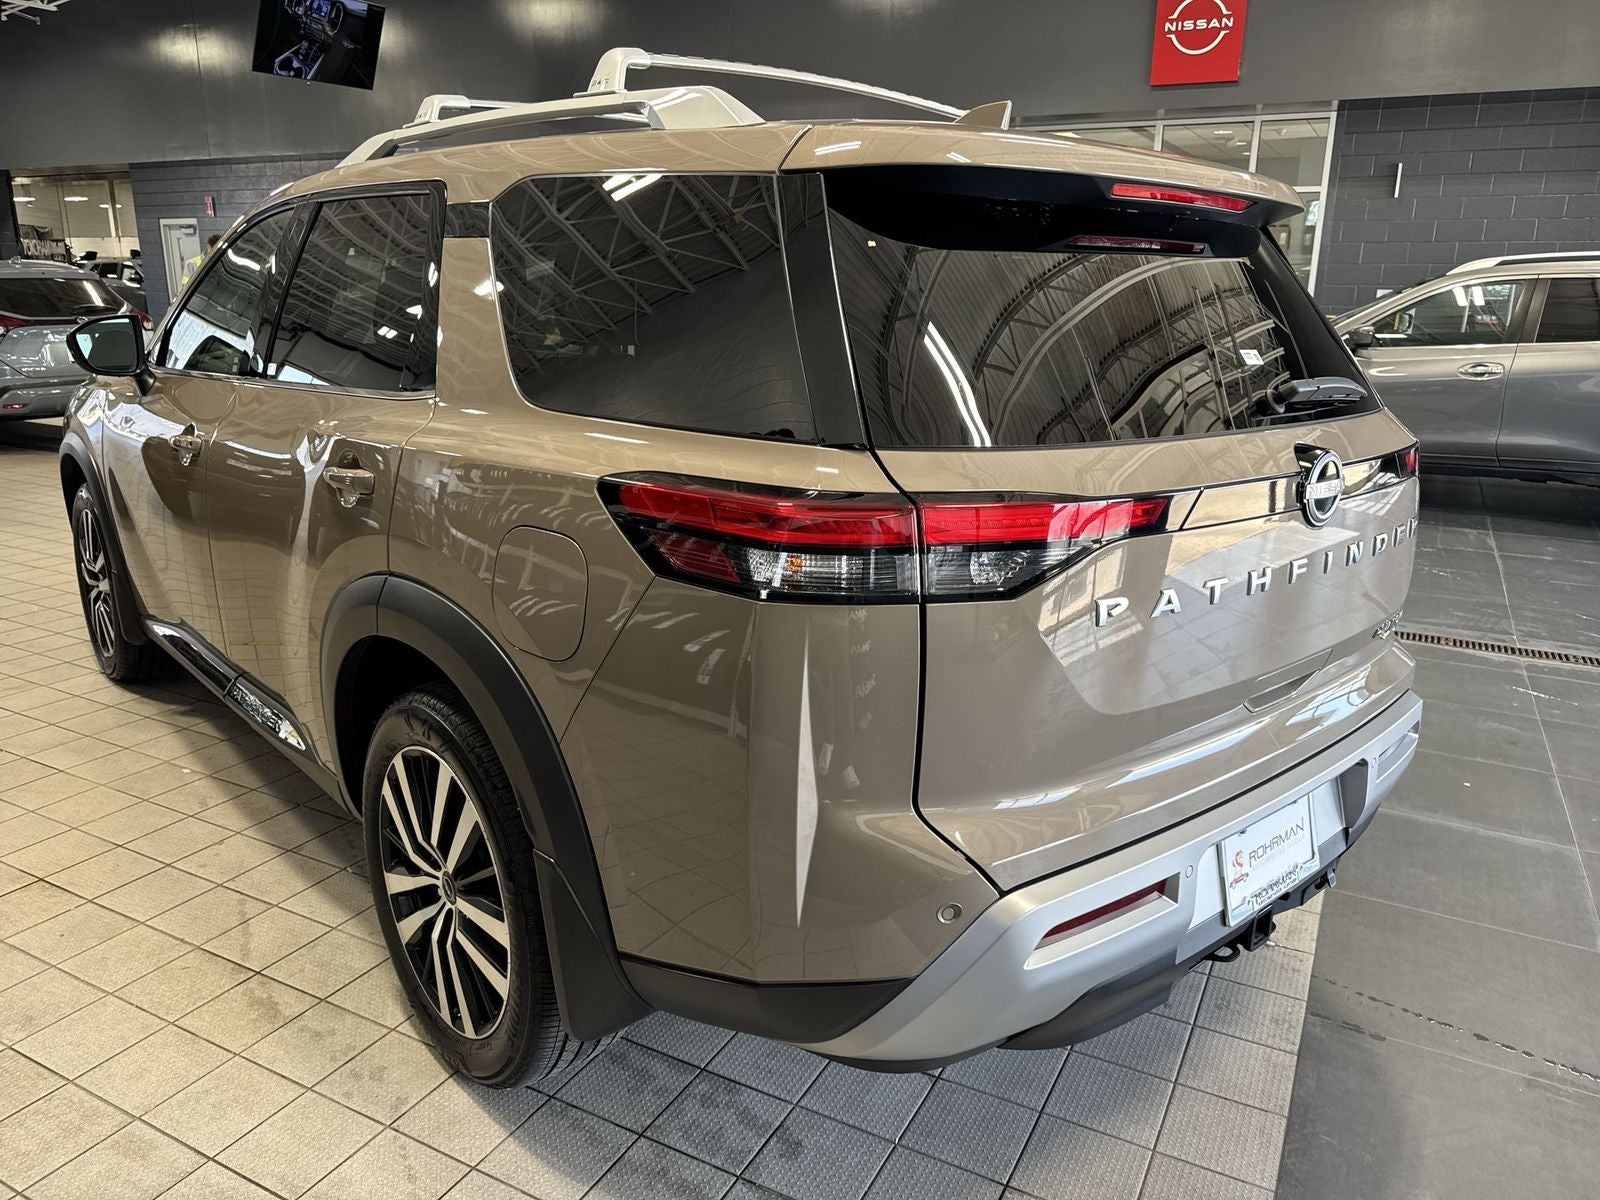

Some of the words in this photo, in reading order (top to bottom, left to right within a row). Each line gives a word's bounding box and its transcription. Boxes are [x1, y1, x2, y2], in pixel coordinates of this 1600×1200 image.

[1164, 16, 1234, 33] NISSAN
[1307, 479, 1344, 499] NISSA
[1249, 816, 1305, 869] ROHRMAN
